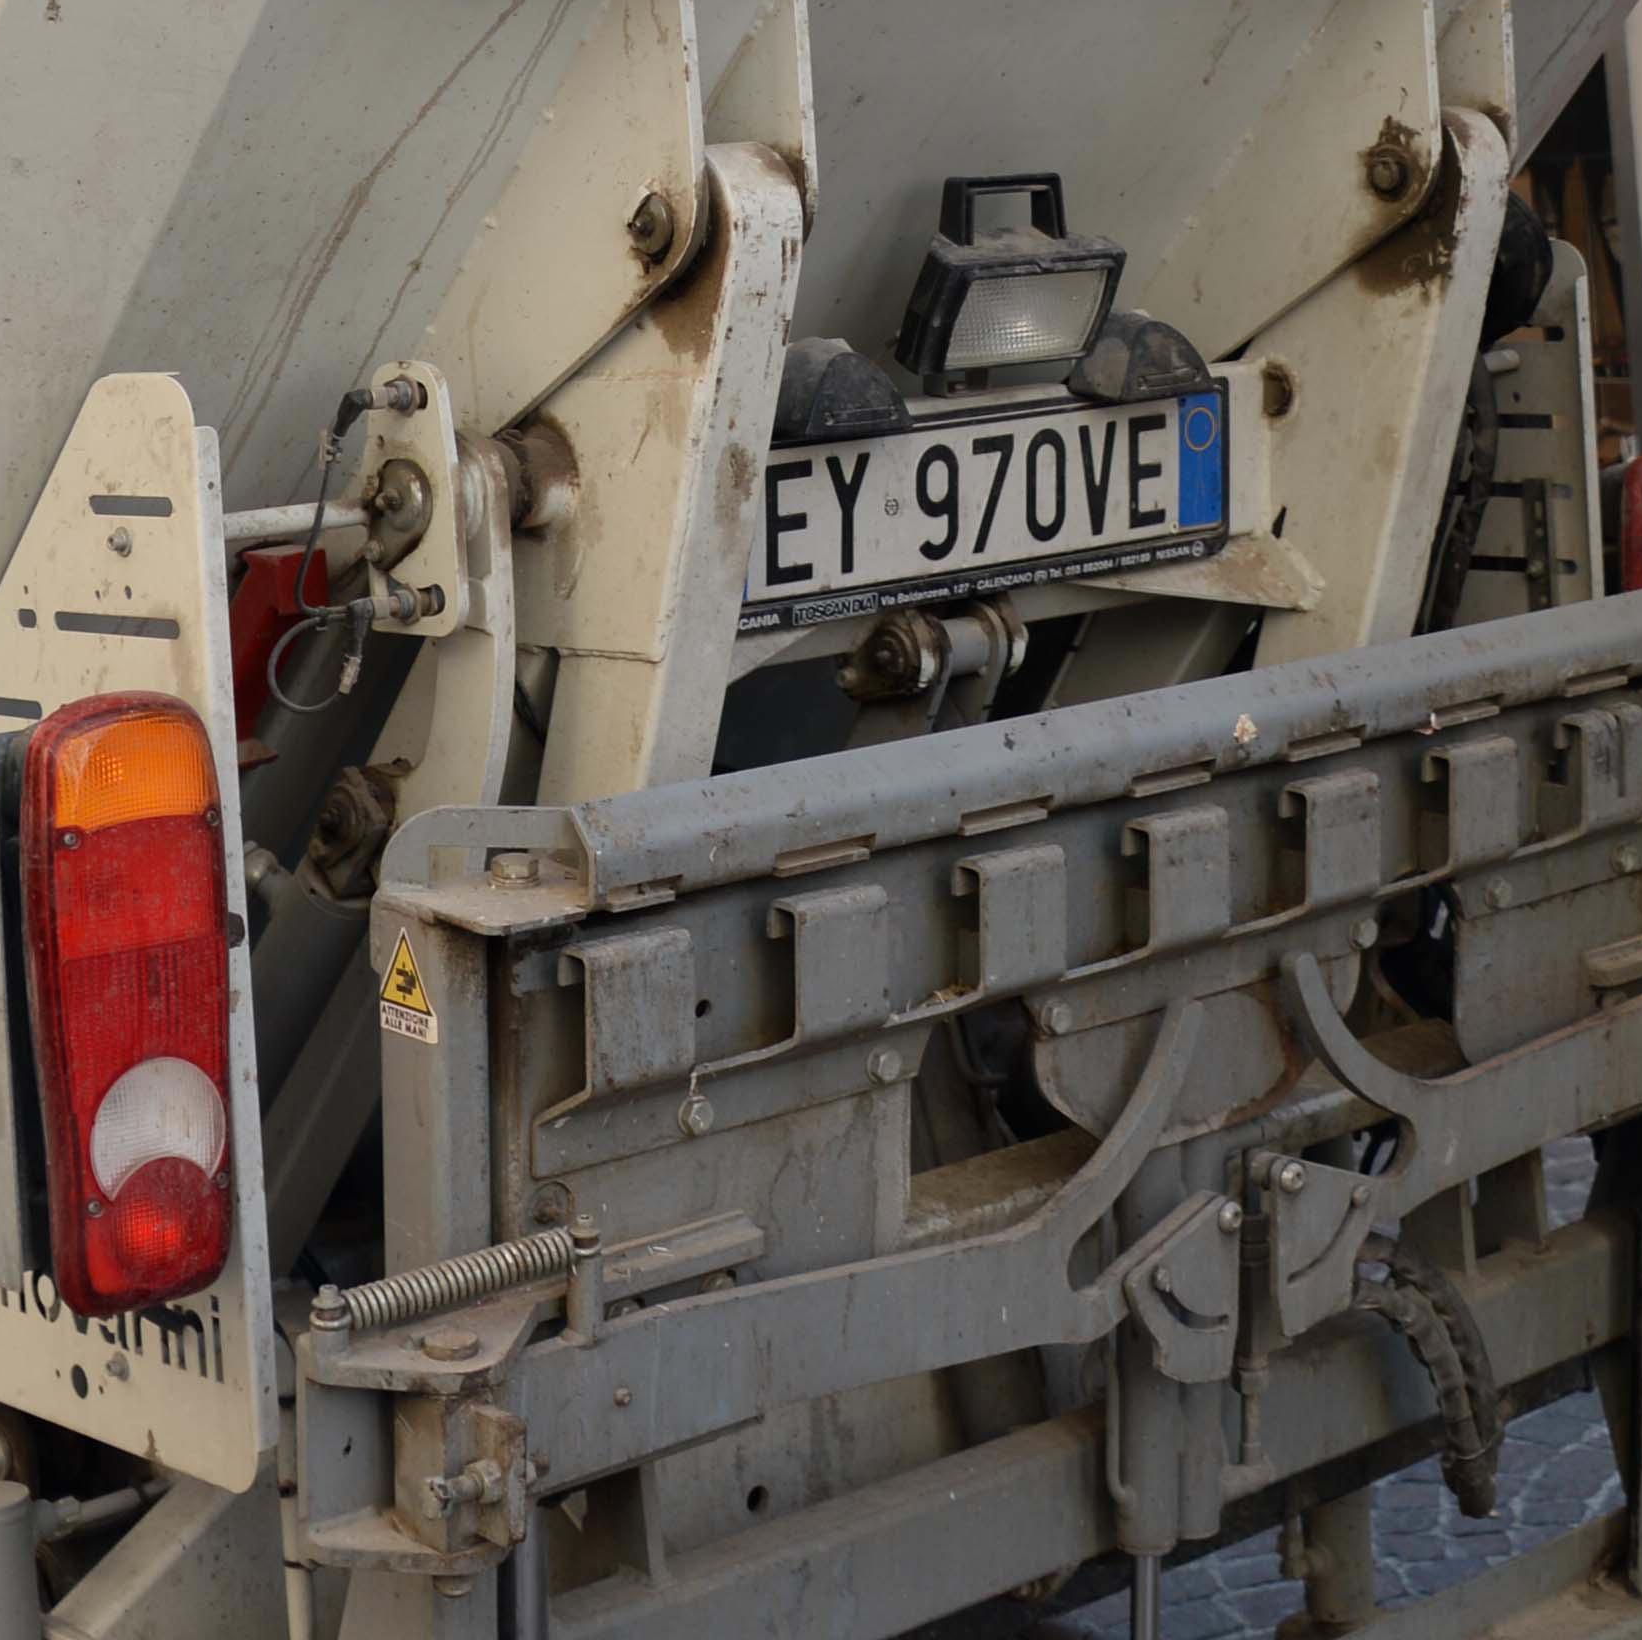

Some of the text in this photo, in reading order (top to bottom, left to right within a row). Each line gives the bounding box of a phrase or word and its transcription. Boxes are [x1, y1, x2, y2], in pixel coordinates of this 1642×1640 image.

[765, 413, 1167, 587] EY 970VE
[738, 613, 780, 630] CANIA
[976, 571, 1033, 590] CALENZANO
[1156, 546, 1190, 560] NISSAN
[382, 1003, 429, 1029] ATTENZIONE
[385, 1016, 426, 1038] ALLE MANI
